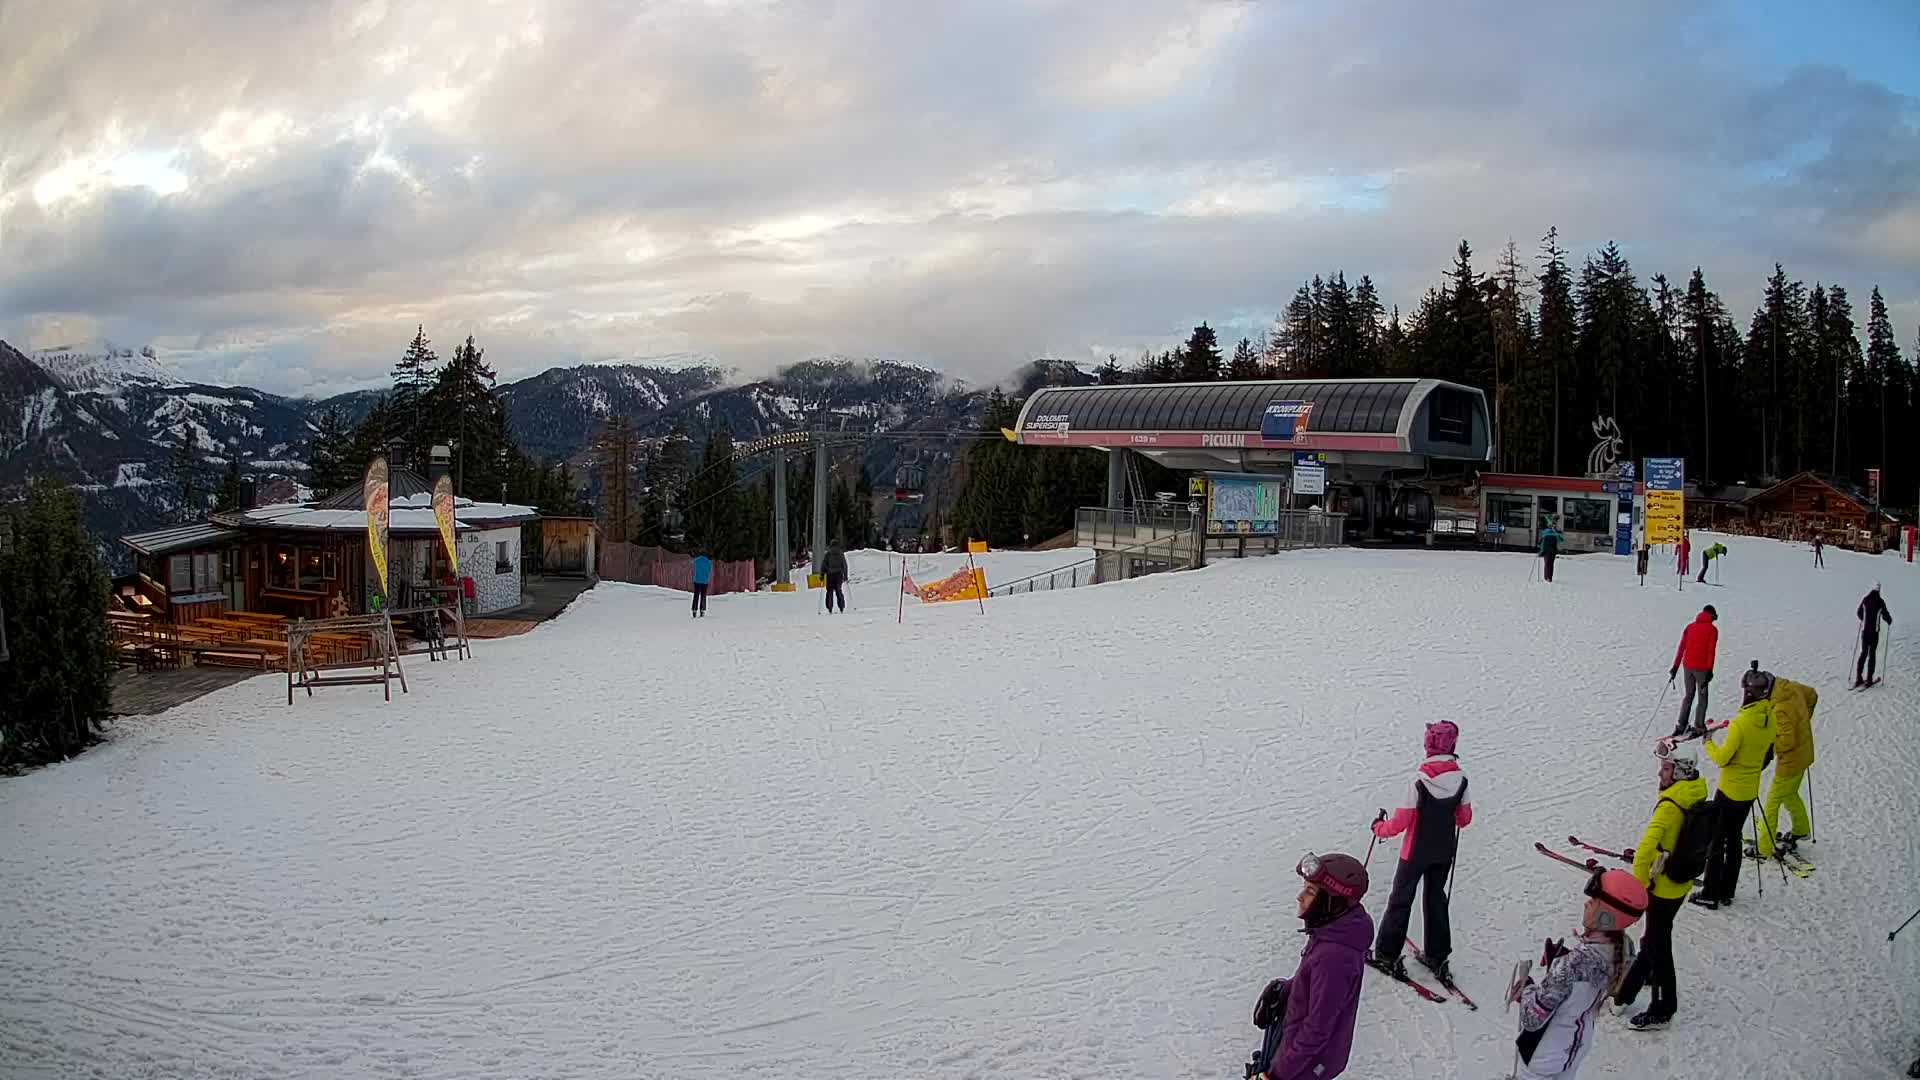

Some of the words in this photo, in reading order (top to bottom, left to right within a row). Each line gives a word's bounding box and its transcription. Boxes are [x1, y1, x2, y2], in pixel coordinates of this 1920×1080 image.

[1266, 405, 1311, 413] KRONPLATZ
[1025, 422, 1058, 430] SUPERSKI
[1202, 434, 1245, 447] PICULIN
